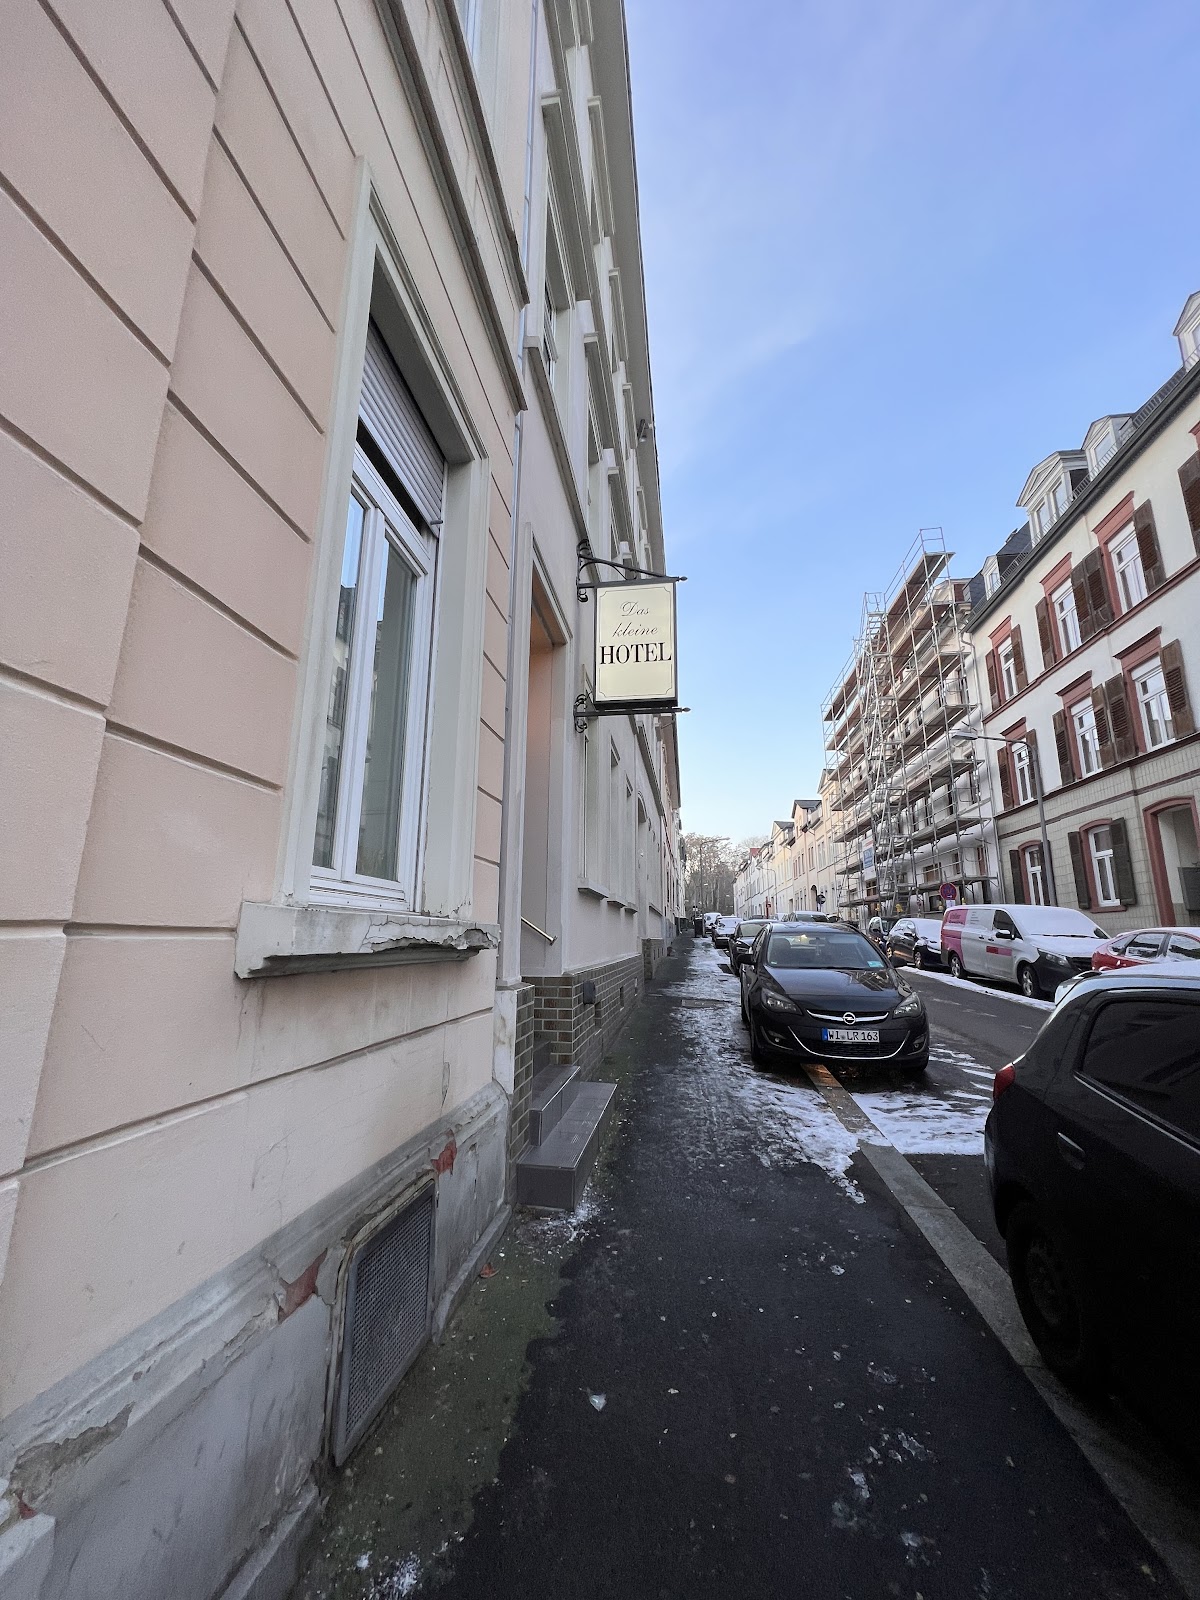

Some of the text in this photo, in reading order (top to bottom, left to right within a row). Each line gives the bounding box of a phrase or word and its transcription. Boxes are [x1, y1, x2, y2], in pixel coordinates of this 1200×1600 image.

[620, 601, 650, 616] Das
[612, 622, 658, 637] kleine
[600, 642, 672, 664] HOTEL
